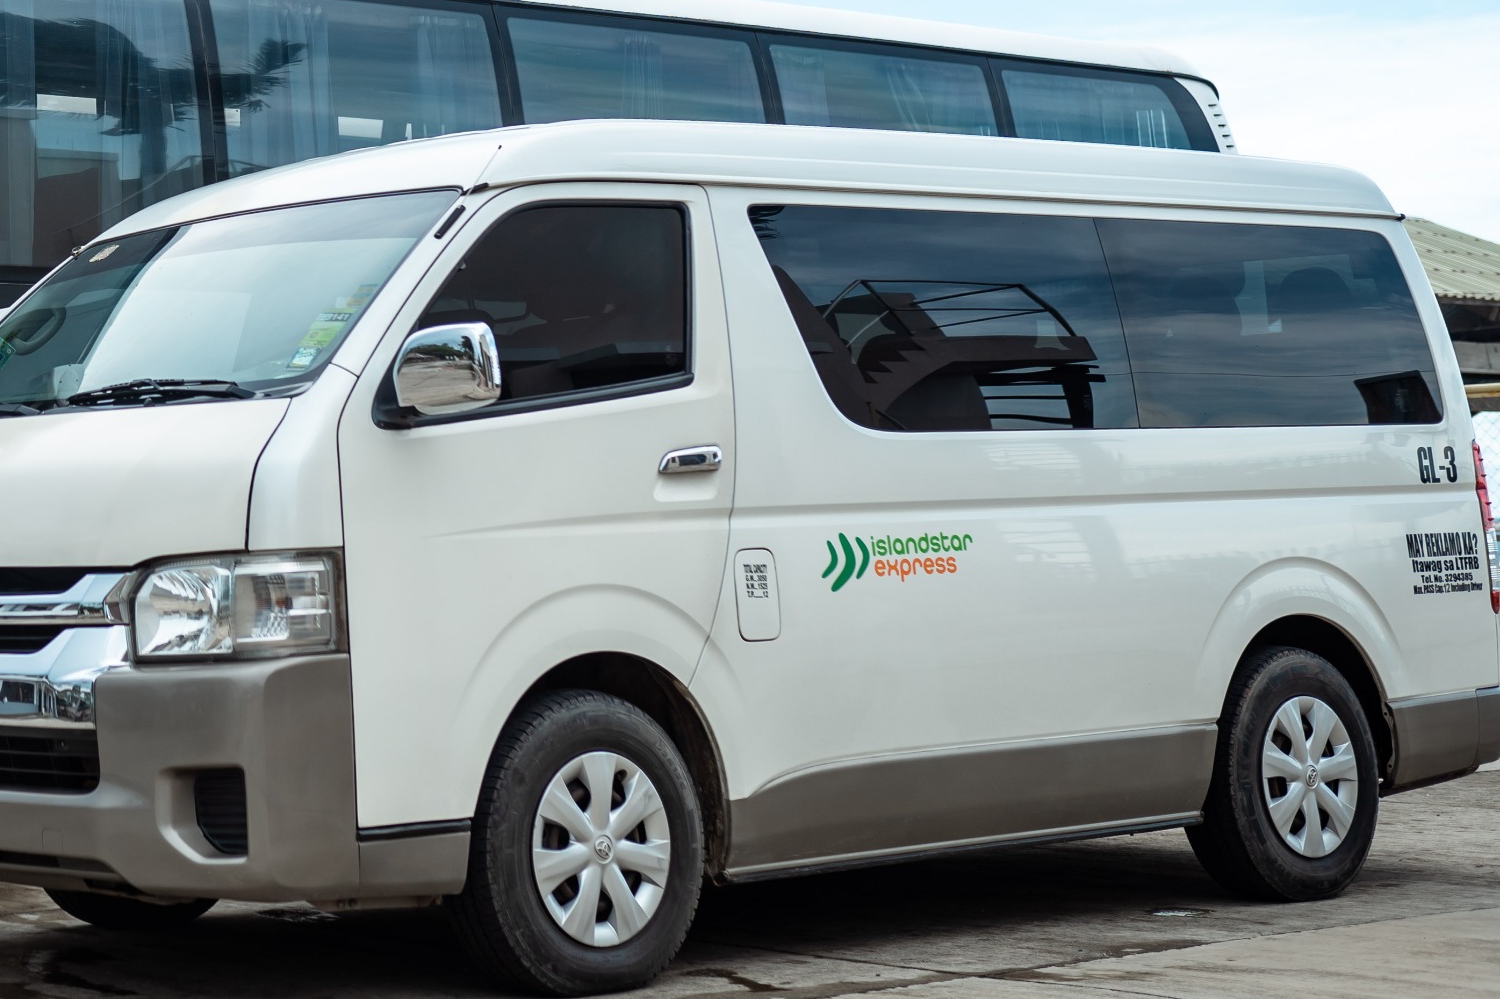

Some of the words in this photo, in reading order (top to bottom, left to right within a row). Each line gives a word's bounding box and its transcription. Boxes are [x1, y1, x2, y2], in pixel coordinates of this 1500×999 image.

[1417, 446, 1458, 484] GL-3
[870, 532, 973, 557] islandstar
[1406, 534, 1425, 558] MAY
[1424, 532, 1463, 557] REKLAMO
[1461, 532, 1478, 555] KA?
[874, 556, 958, 583] express
[1412, 559, 1443, 573] Itawag
[1443, 560, 1454, 571] sa
[1455, 556, 1480, 571] LTFRB
[1423, 584, 1434, 594] PASS
[1450, 582, 1471, 593] Including
[1434, 574, 1444, 583] No.
[1444, 572, 1474, 582] 3294385
